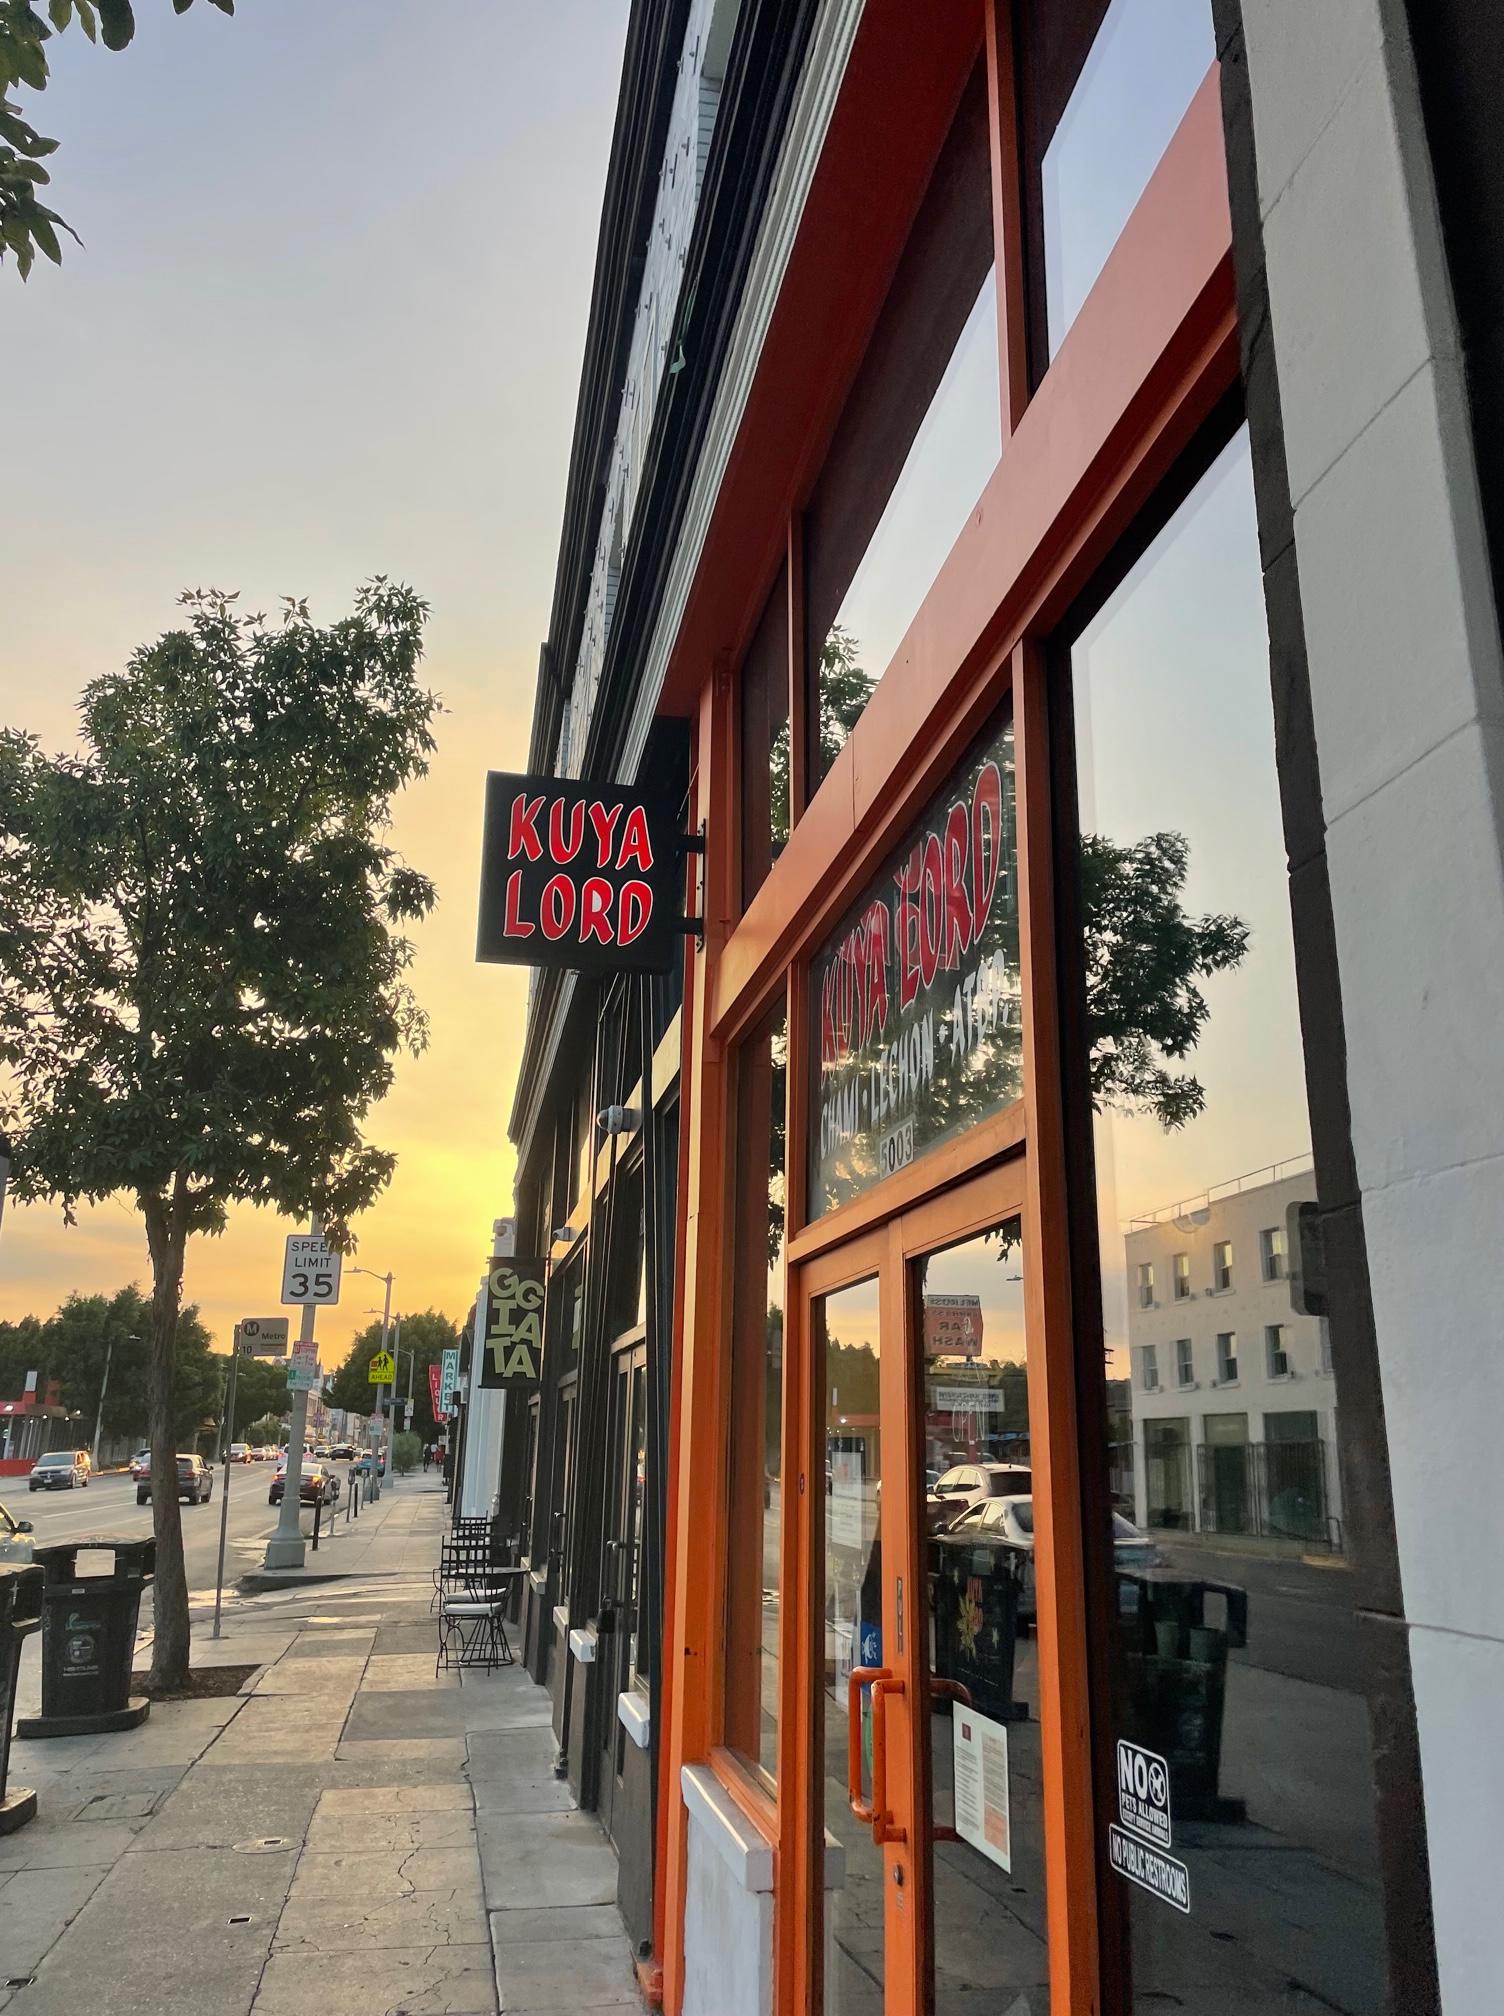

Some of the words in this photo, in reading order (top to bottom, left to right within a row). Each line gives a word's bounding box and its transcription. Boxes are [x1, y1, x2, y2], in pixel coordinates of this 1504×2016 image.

[507, 793, 654, 872] KUYA
[503, 869, 654, 947] LORD
[820, 900, 889, 1090] KUYA
[901, 761, 1001, 1014] LORD
[871, 1007, 935, 1123] LECHON
[881, 1124, 912, 1174] 5003
[291, 1241, 328, 1253] SPEE
[295, 1257, 332, 1268] LIMIT
[289, 1273, 332, 1298] 35
[242, 1345, 252, 1354] 10
[261, 1332, 286, 1340] Metro
[370, 1373, 393, 1381] AHEAD
[444, 1351, 456, 1411] MARKET
[1119, 1745, 1148, 1800] NO
[1121, 1791, 1137, 1814] PETS
[1138, 1800, 1168, 1830] ALLOWED
[1122, 1838, 1145, 1879] PUBLIC
[1145, 1850, 1187, 1905] RESTROOMS
